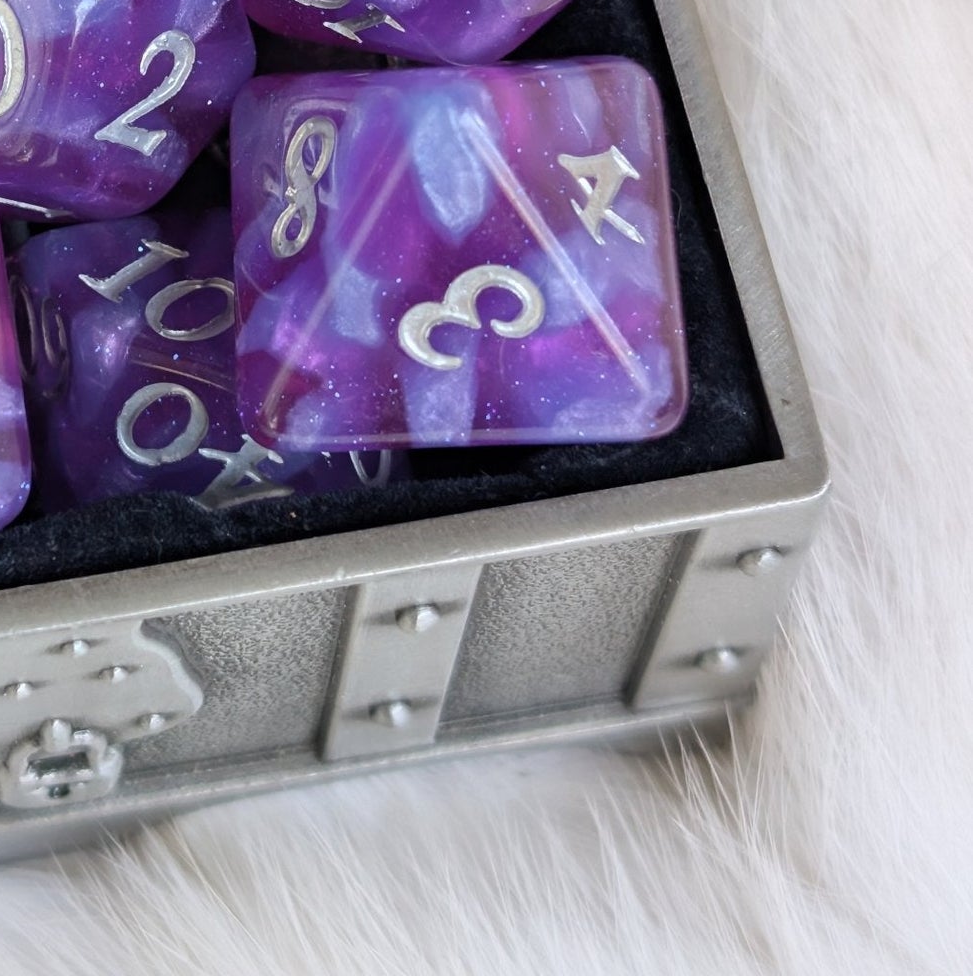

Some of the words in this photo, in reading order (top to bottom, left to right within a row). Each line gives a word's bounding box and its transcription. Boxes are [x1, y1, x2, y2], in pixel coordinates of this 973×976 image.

[95, 30, 196, 157] 2
[271, 114, 338, 258] 8
[558, 144, 646, 245] 4
[78, 238, 236, 342] 10
[398, 264, 545, 371] 3
